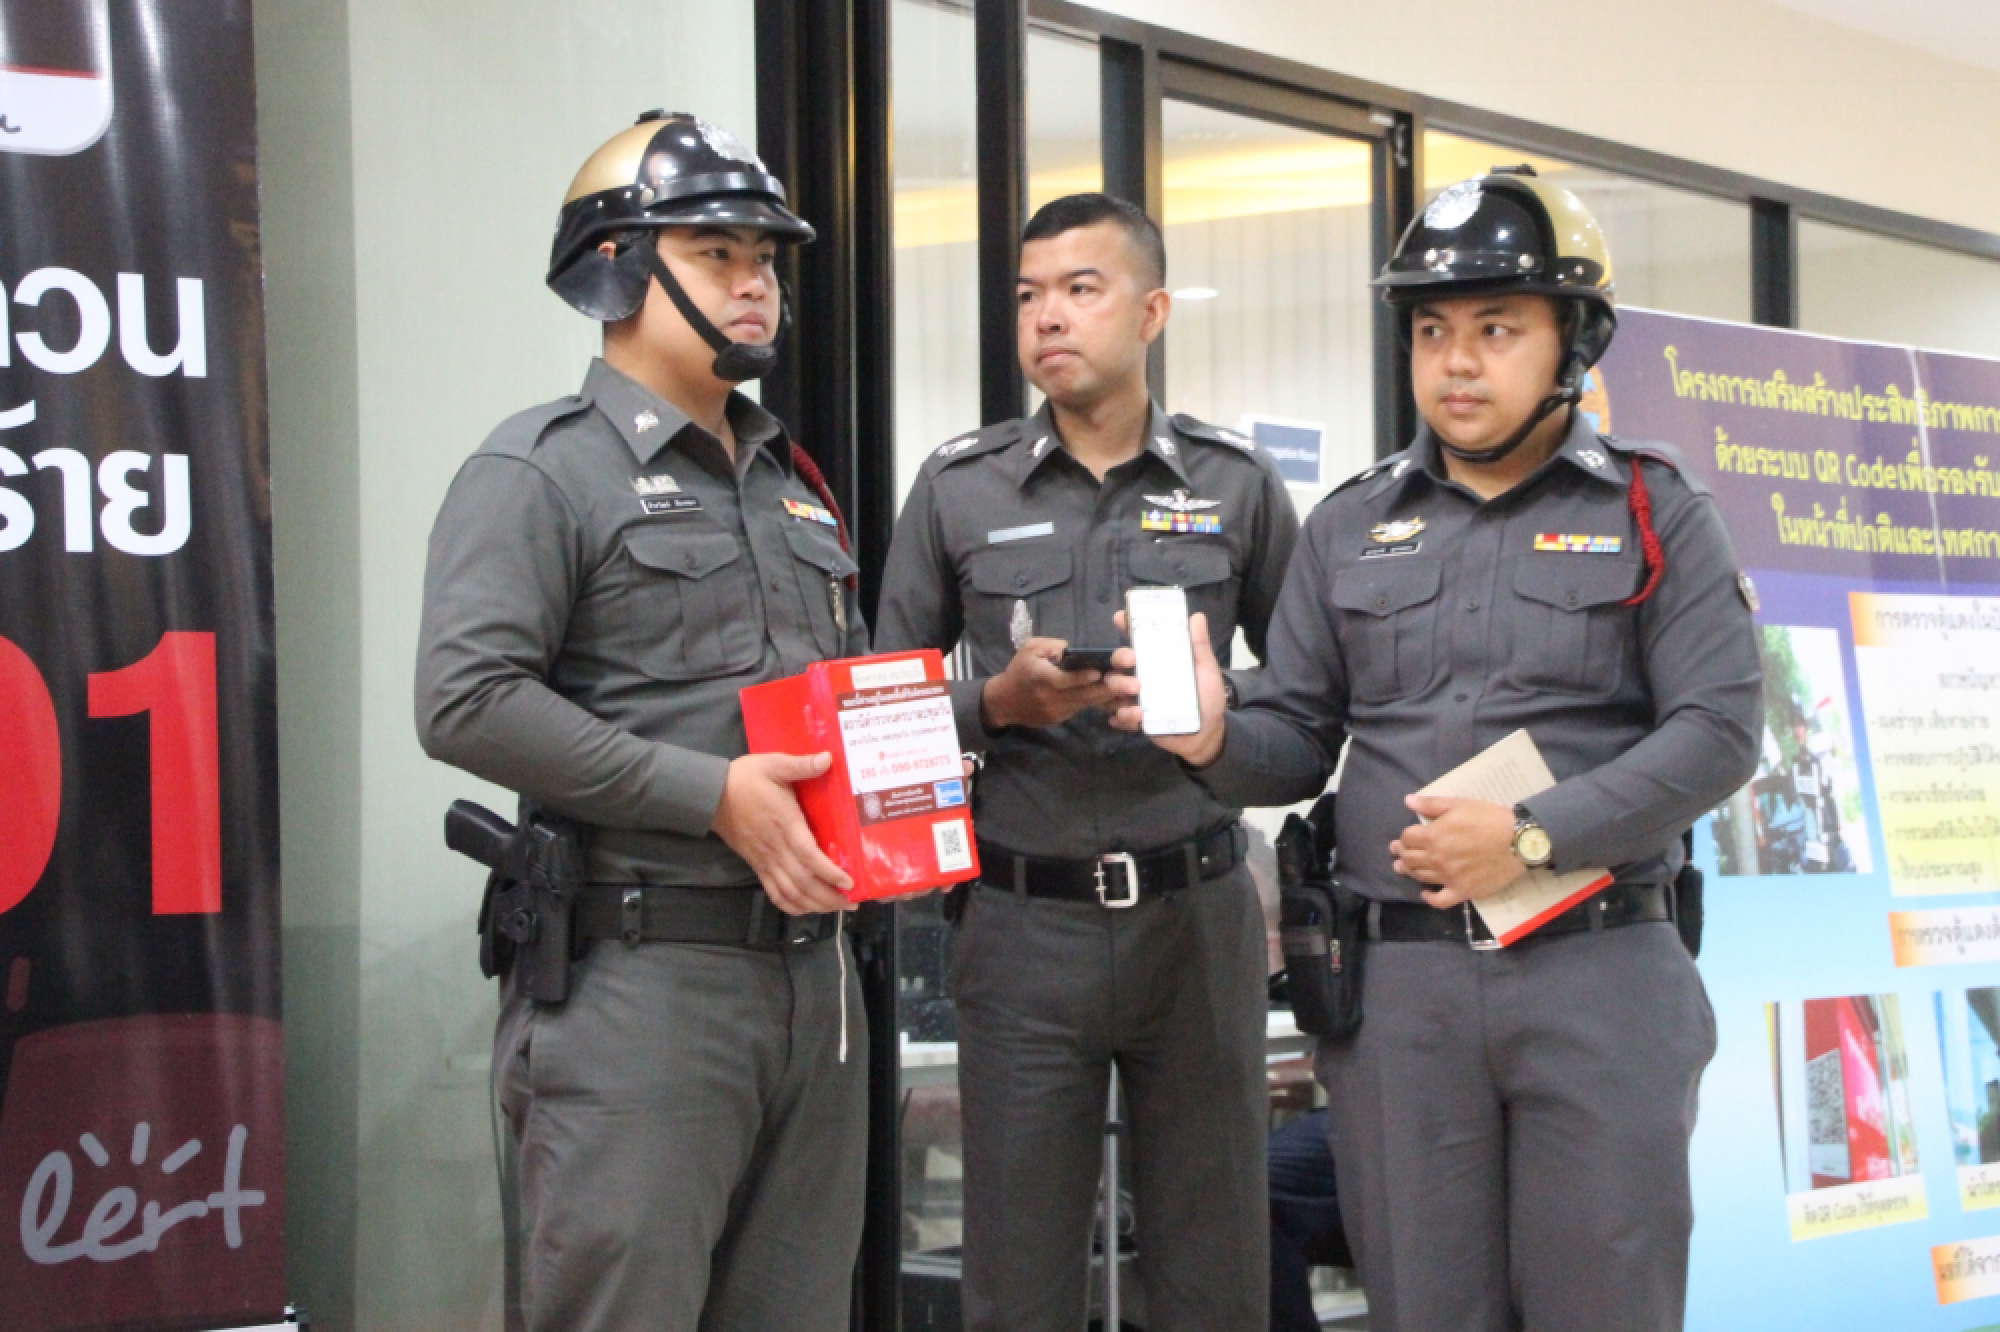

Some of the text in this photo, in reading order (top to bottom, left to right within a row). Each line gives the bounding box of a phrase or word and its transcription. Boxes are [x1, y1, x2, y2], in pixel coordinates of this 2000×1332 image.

[0, 266, 207, 379] วน
[1664, 346, 2000, 434] โครงการเสริมสร้างประสิทธิภาพกา
[1715, 426, 1810, 481] ด้วยระบบ
[1814, 448, 1843, 485] QR
